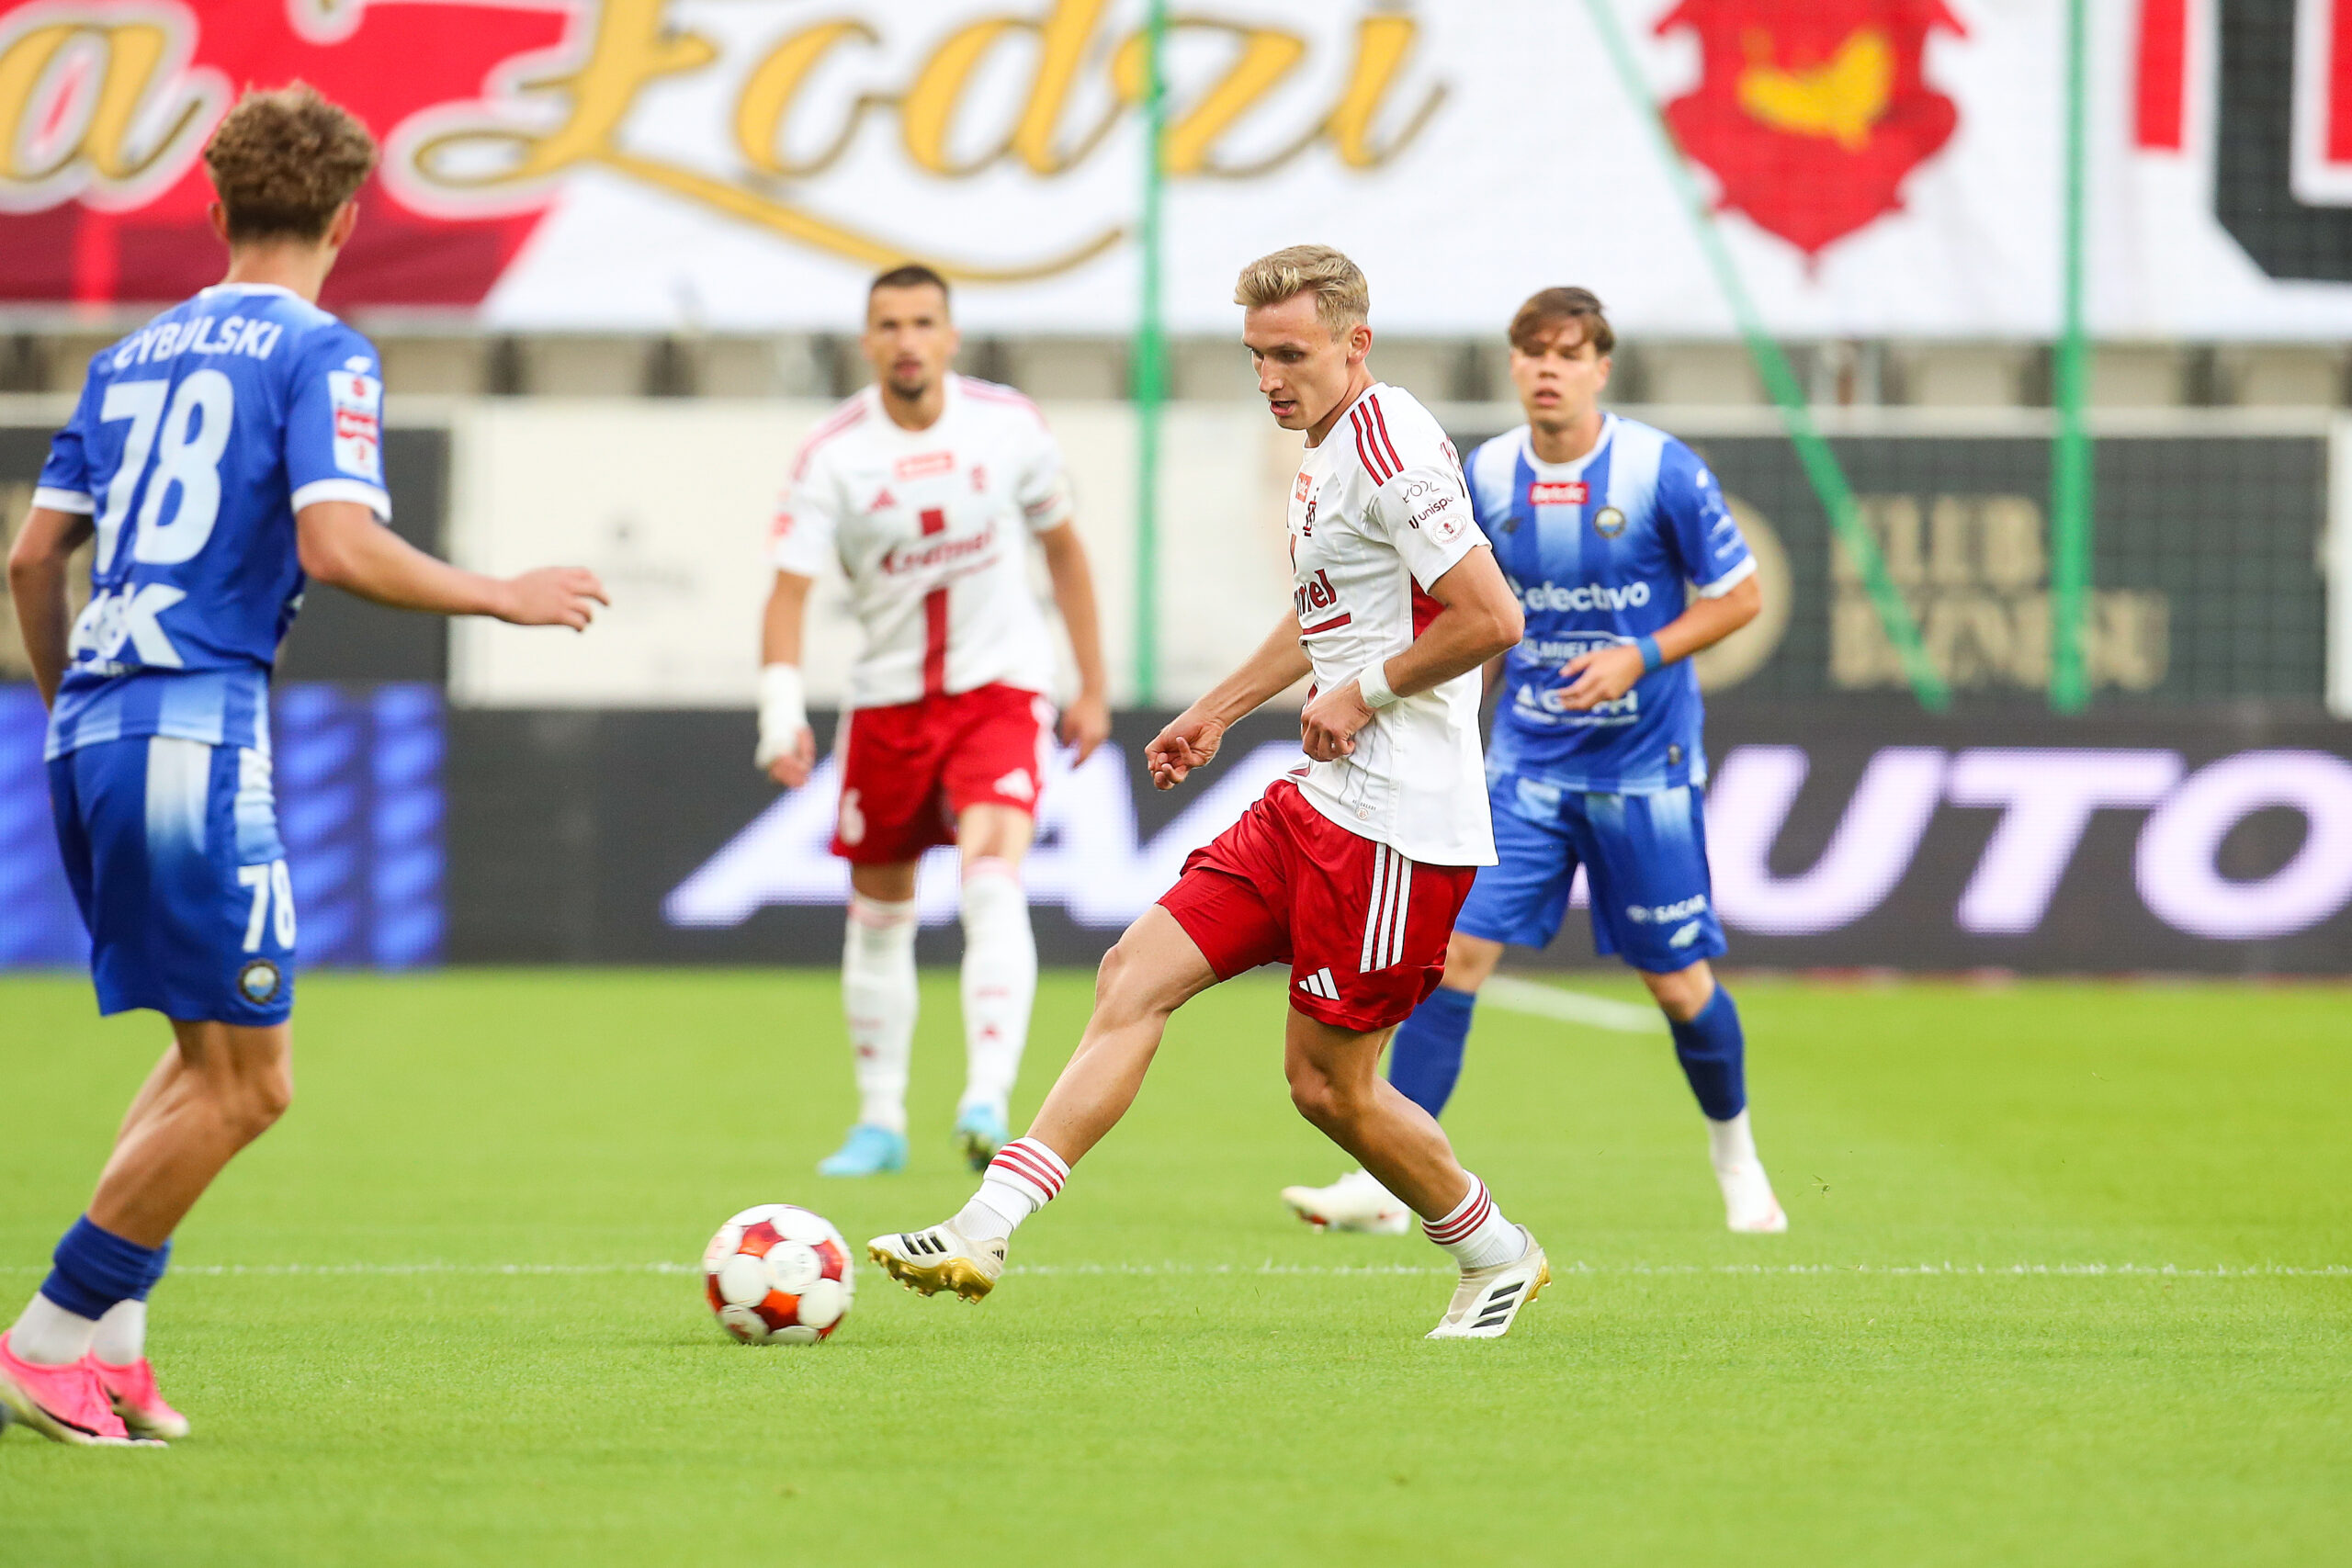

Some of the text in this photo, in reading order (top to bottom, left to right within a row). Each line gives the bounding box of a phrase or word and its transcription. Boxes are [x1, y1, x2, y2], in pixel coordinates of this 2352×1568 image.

[113, 315, 283, 369] CYBULSKI
[96, 368, 233, 575] 78
[237, 859, 297, 953] 78
[1568, 744, 2352, 939] UTO
